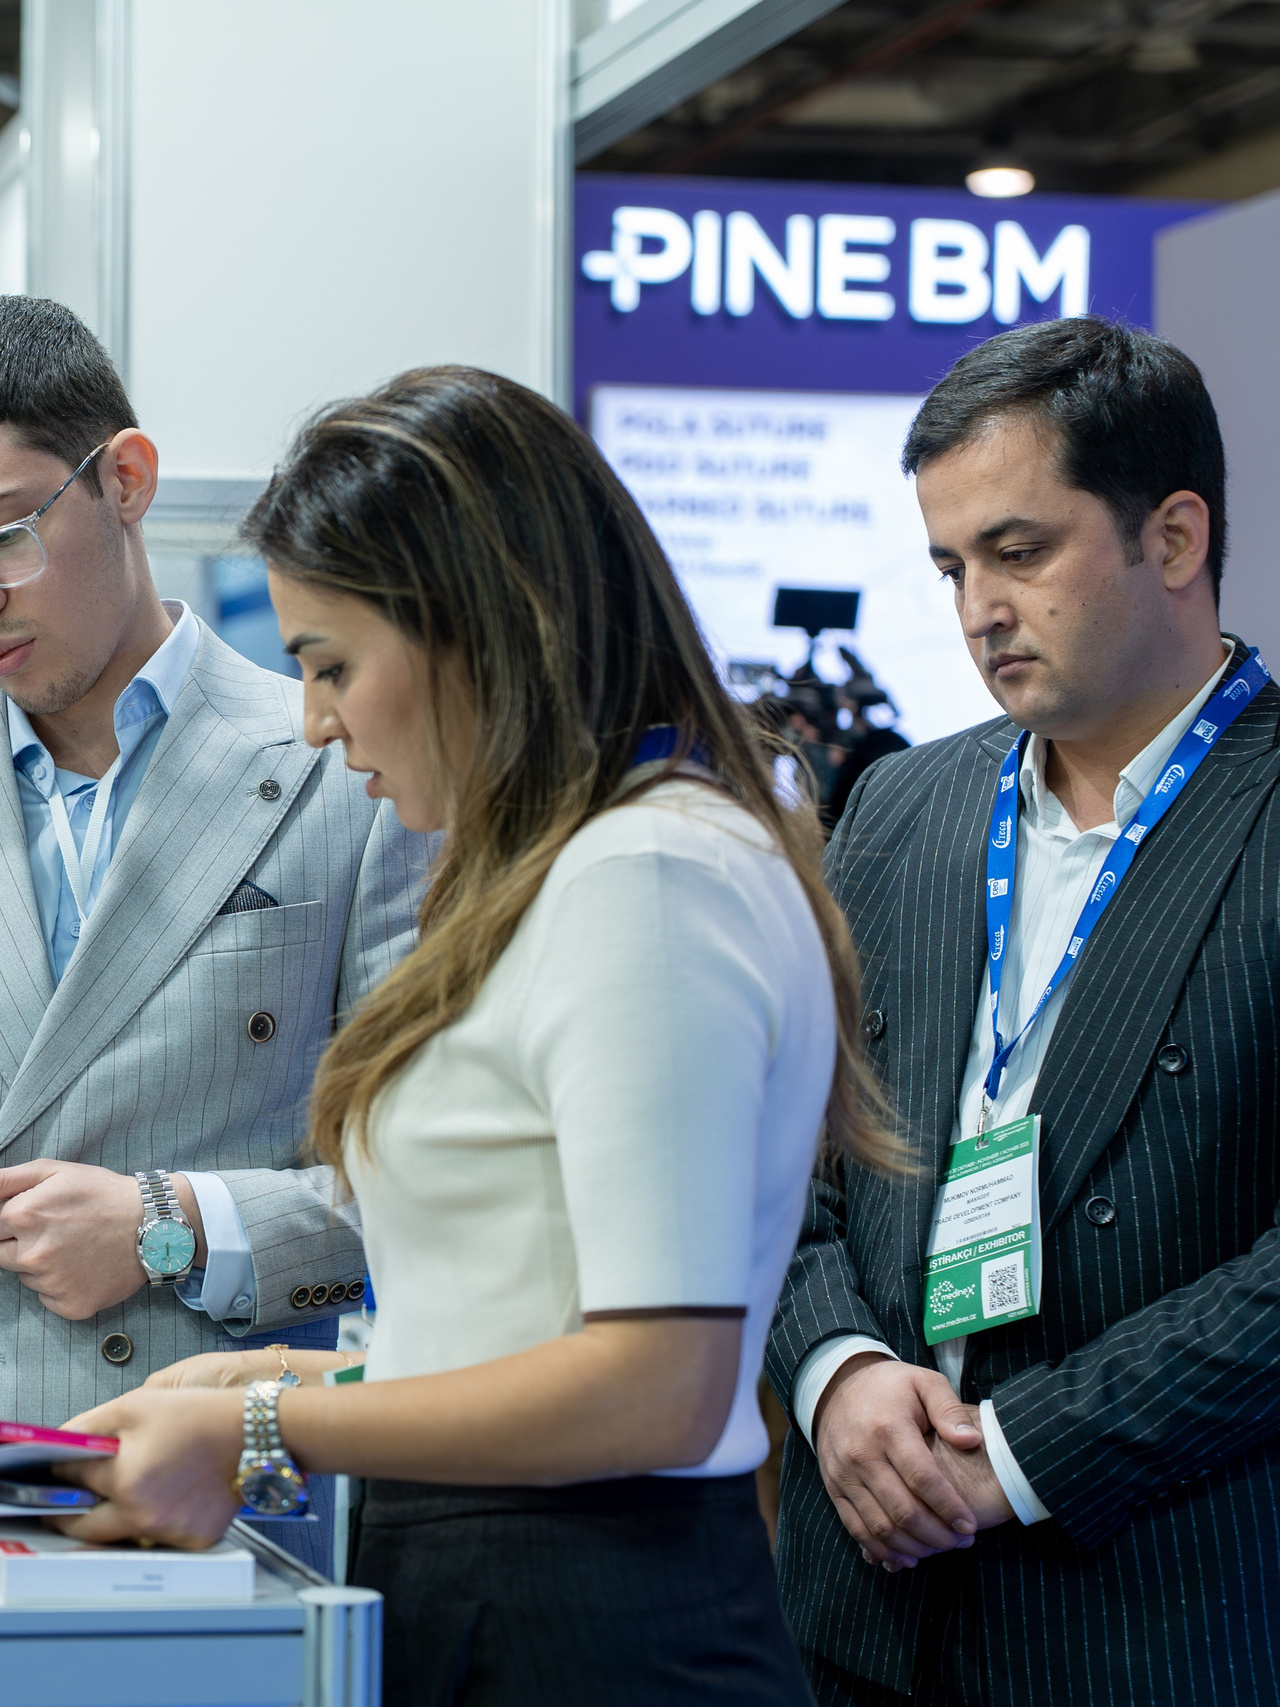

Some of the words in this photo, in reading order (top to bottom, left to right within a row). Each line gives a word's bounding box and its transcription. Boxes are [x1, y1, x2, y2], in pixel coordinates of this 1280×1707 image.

[582, 205, 896, 322] PINE
[908, 217, 1091, 325] BM
[969, 1173, 1014, 1196] NORMUHAMMAD
[953, 1200, 993, 1220] DEVELOPMENT
[994, 1190, 1022, 1206] COMPANY
[978, 1230, 1026, 1253] EXHIBITOR
